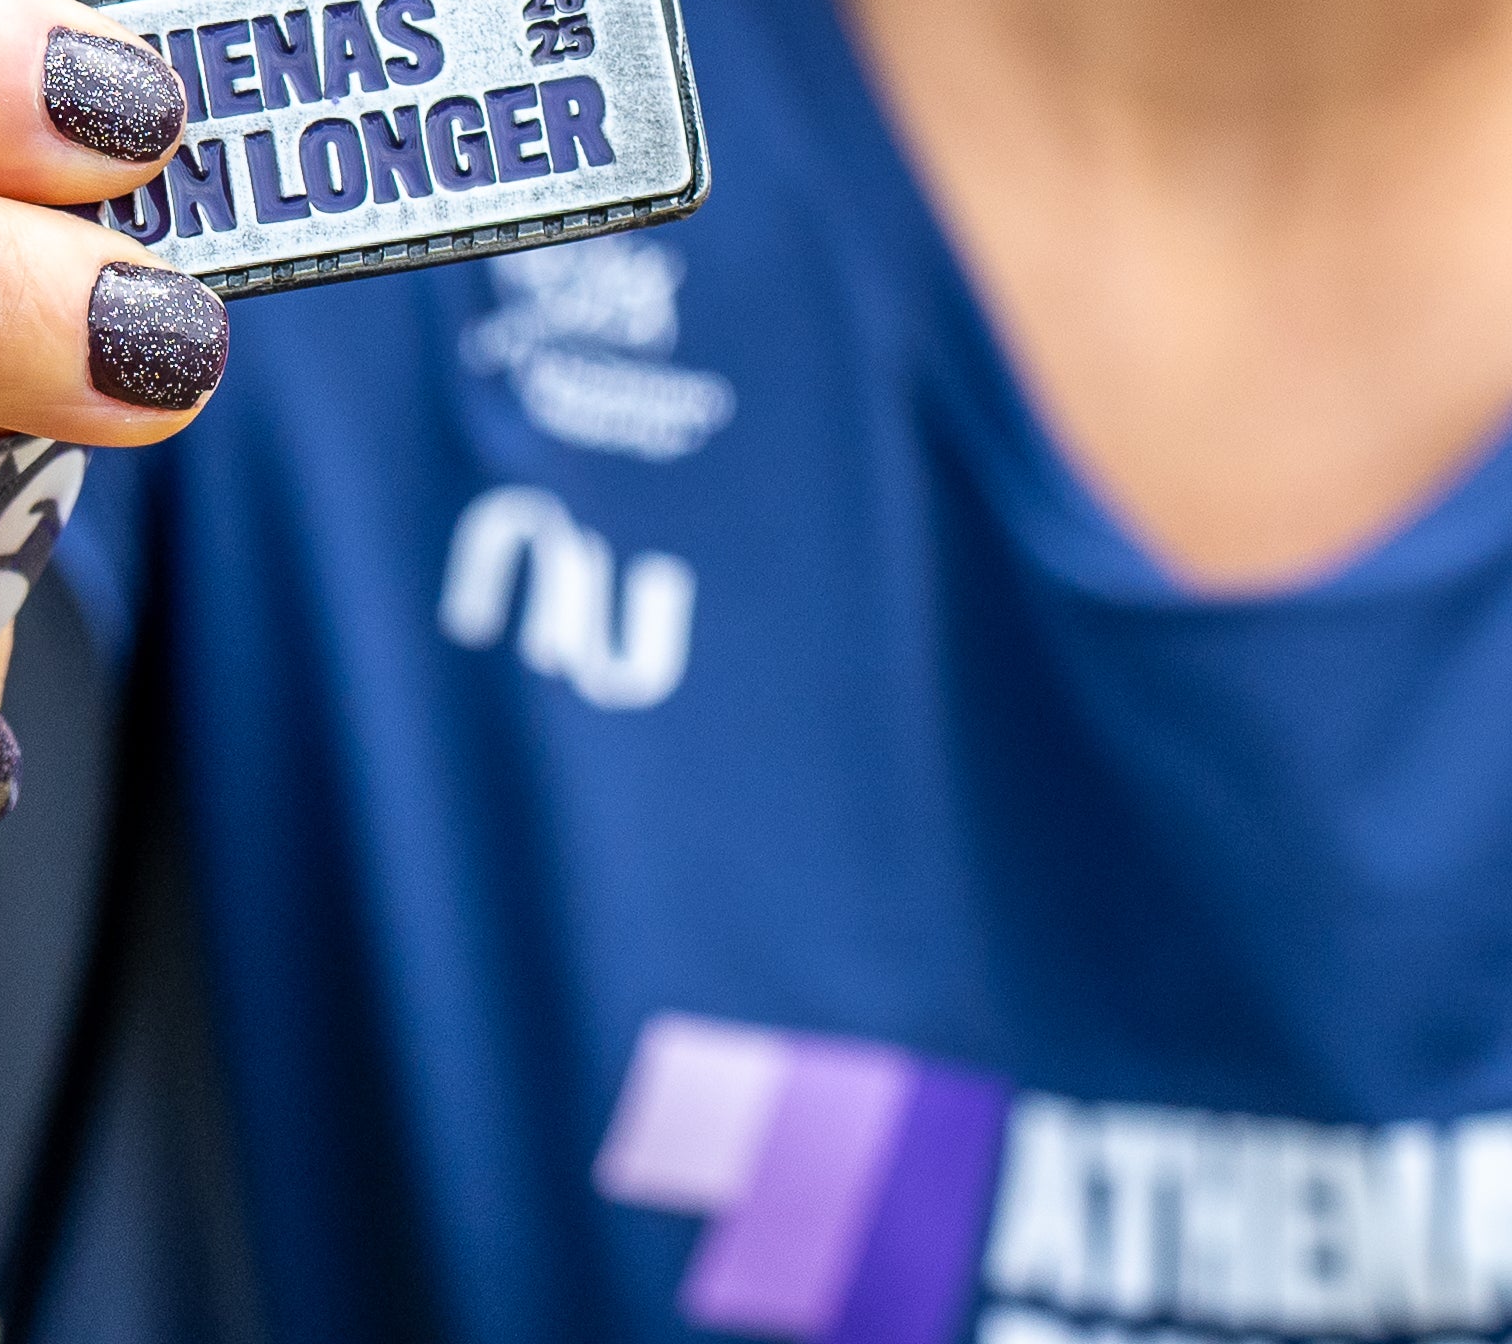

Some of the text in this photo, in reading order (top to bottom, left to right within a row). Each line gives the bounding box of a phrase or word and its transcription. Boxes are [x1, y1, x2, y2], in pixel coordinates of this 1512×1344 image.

[526, 16, 595, 66] 25
[98, 75, 616, 246] UN LONGER
